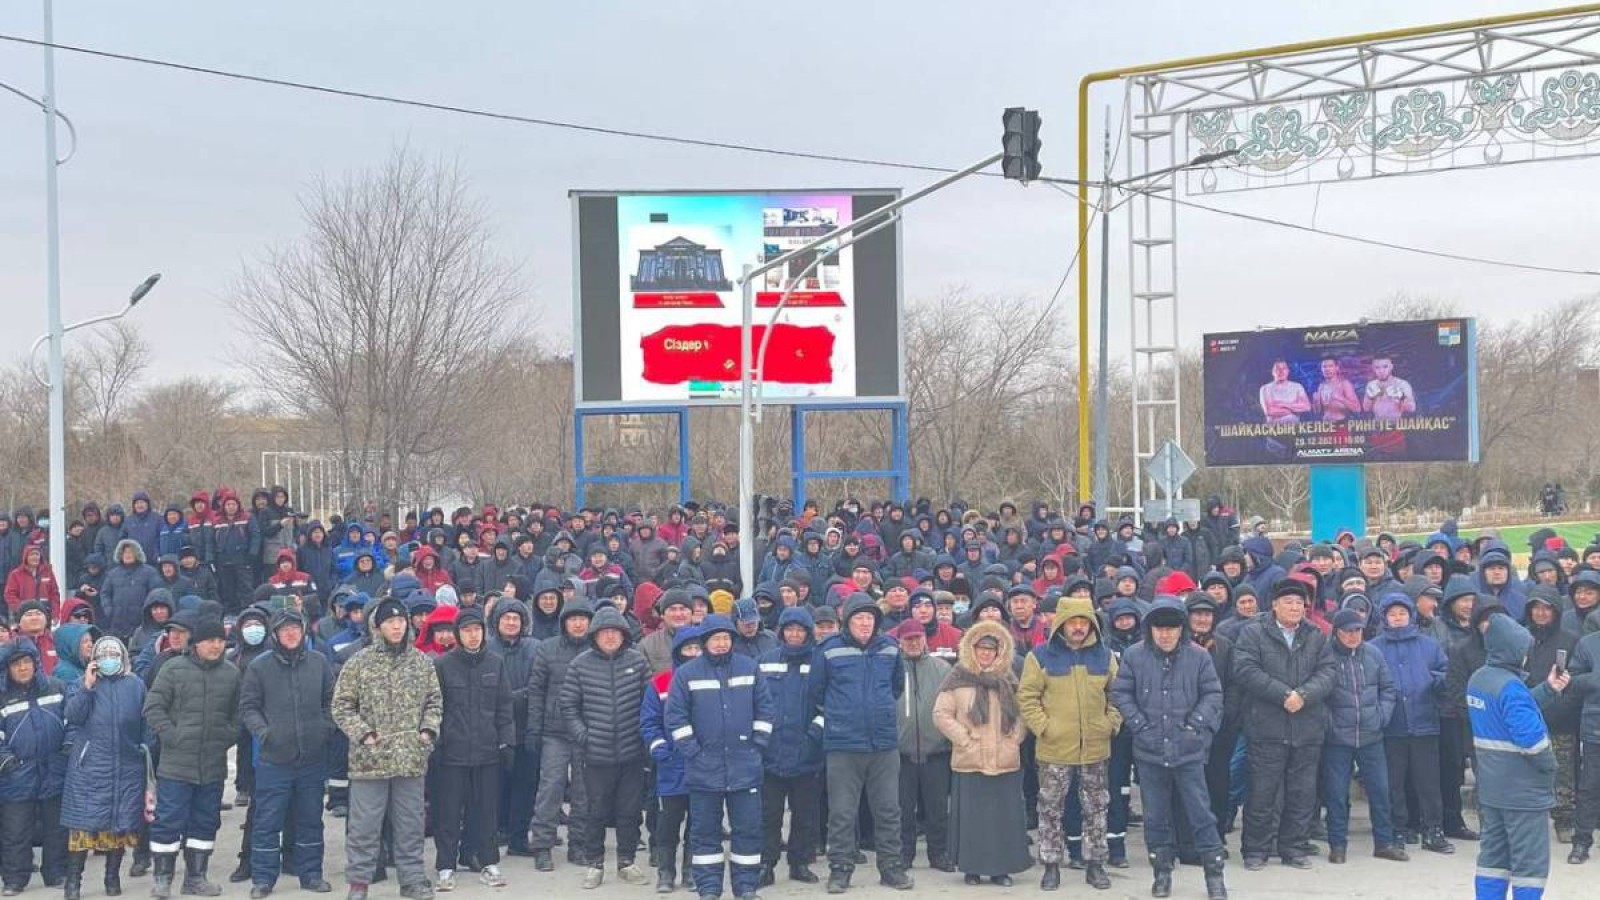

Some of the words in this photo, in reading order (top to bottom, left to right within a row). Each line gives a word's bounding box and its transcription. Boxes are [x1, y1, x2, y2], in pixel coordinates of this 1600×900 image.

[1303, 329, 1359, 341] NAIZA
[1299, 420, 1336, 433] КЕЛСЕ
[1297, 448, 1334, 457] ALMATY
[1333, 446, 1365, 456] ARENA
